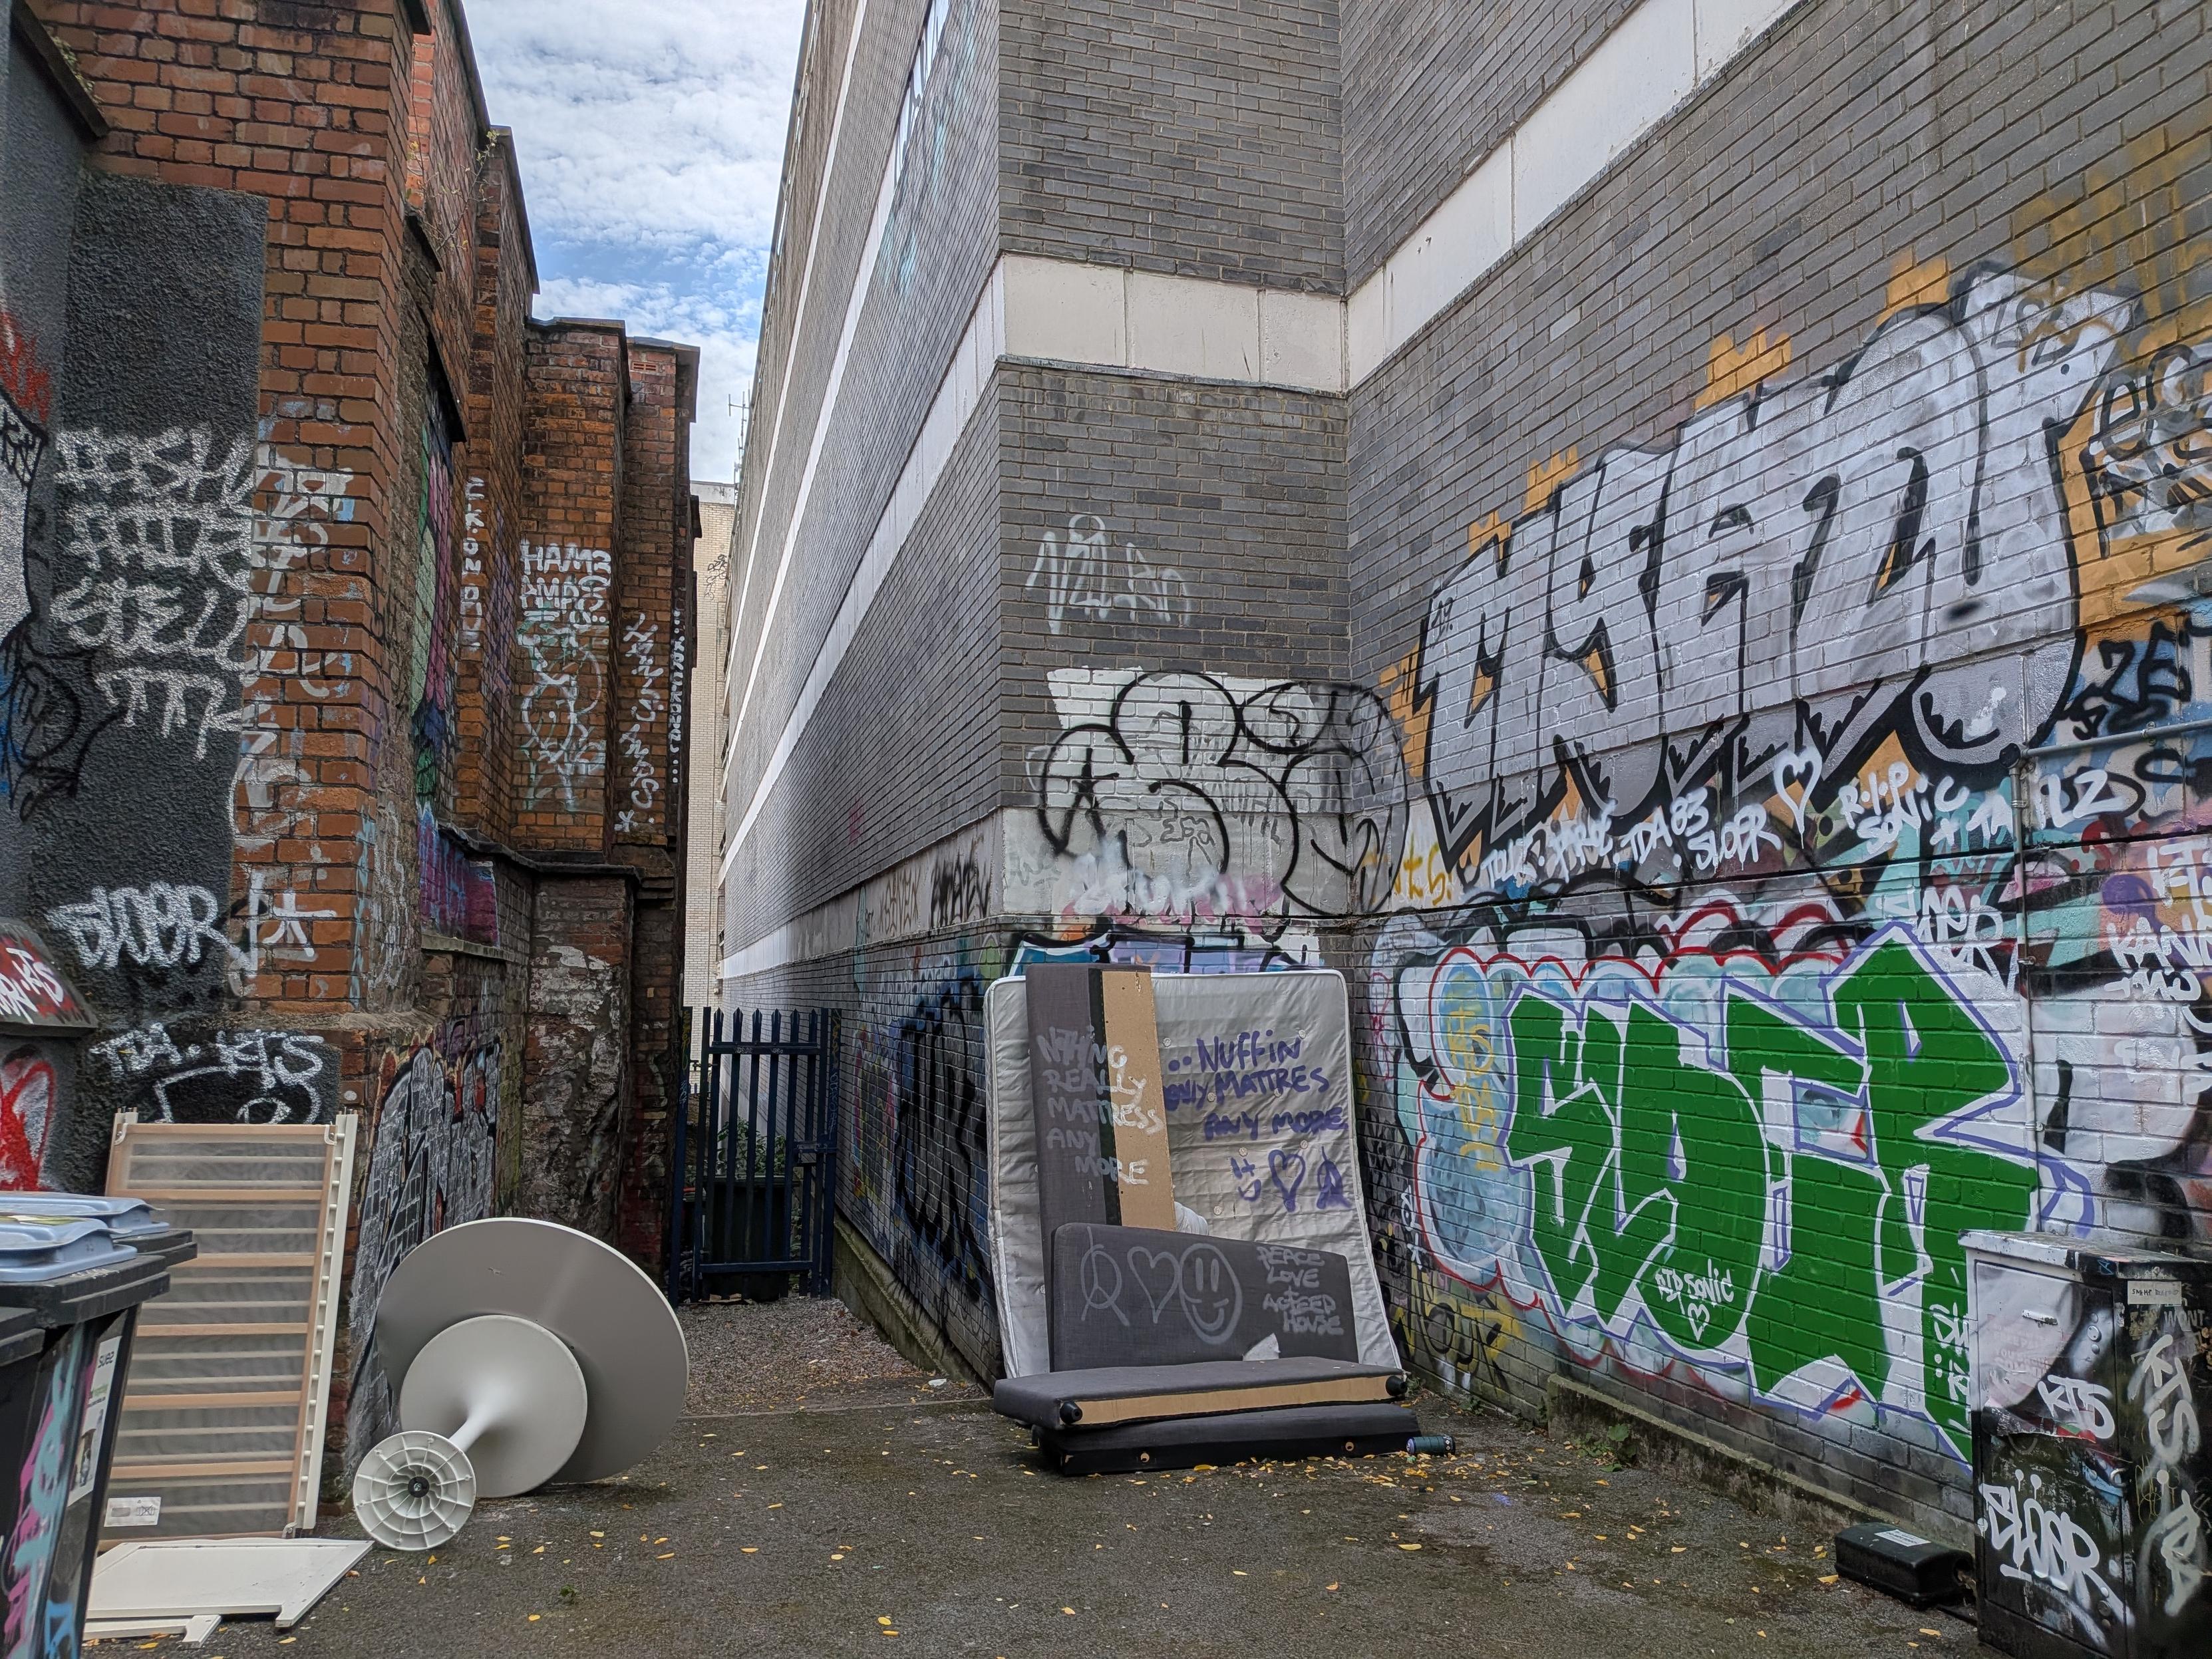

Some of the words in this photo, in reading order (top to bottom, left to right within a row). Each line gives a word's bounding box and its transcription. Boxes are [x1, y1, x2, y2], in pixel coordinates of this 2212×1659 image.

[1670, 786, 1709, 837] 83
[1046, 1096, 1166, 1135] MATTRESS
[1046, 1128, 1098, 1157] ANY
[1074, 1155, 1150, 1185] MORE
[1256, 1246, 1325, 1271] PEACE
[1266, 1266, 1321, 1288] LOVE
